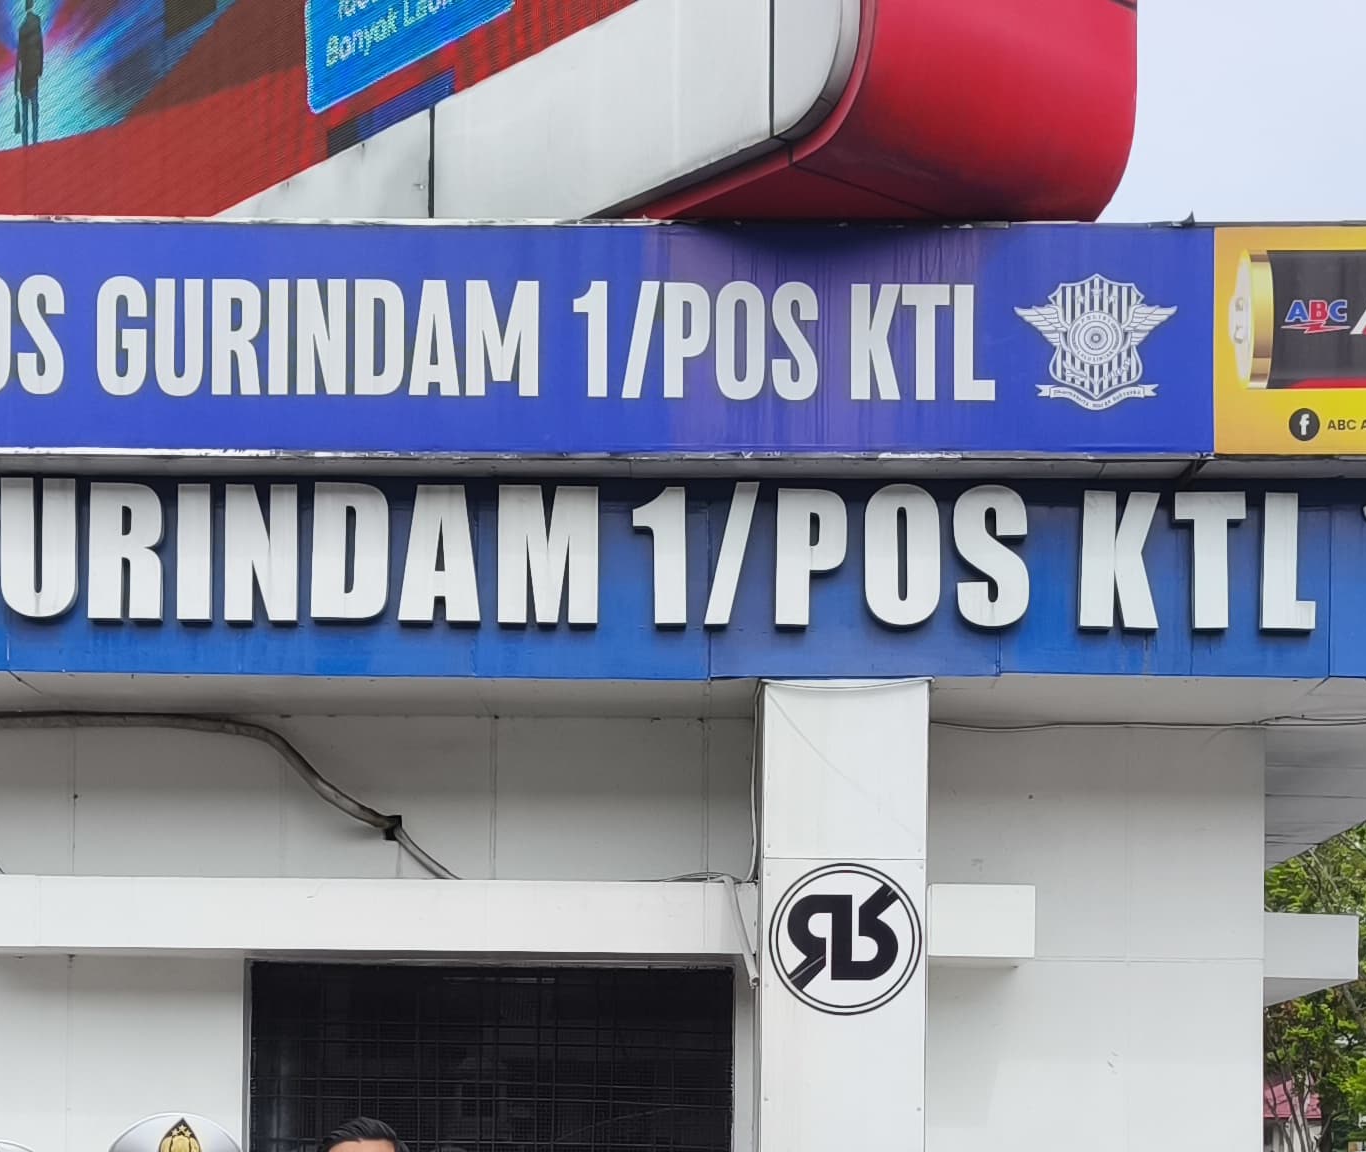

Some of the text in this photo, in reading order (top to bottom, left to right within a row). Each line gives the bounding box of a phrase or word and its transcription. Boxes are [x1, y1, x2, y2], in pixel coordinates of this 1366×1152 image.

[96, 275, 539, 398] GURINDAM
[573, 280, 819, 401] 1/POS
[850, 284, 996, 402] KTL
[1286, 299, 1348, 323] ABC
[1327, 418, 1357, 431] ABC
[632, 481, 1030, 630] 1/POS
[1077, 490, 1317, 631] KTL
